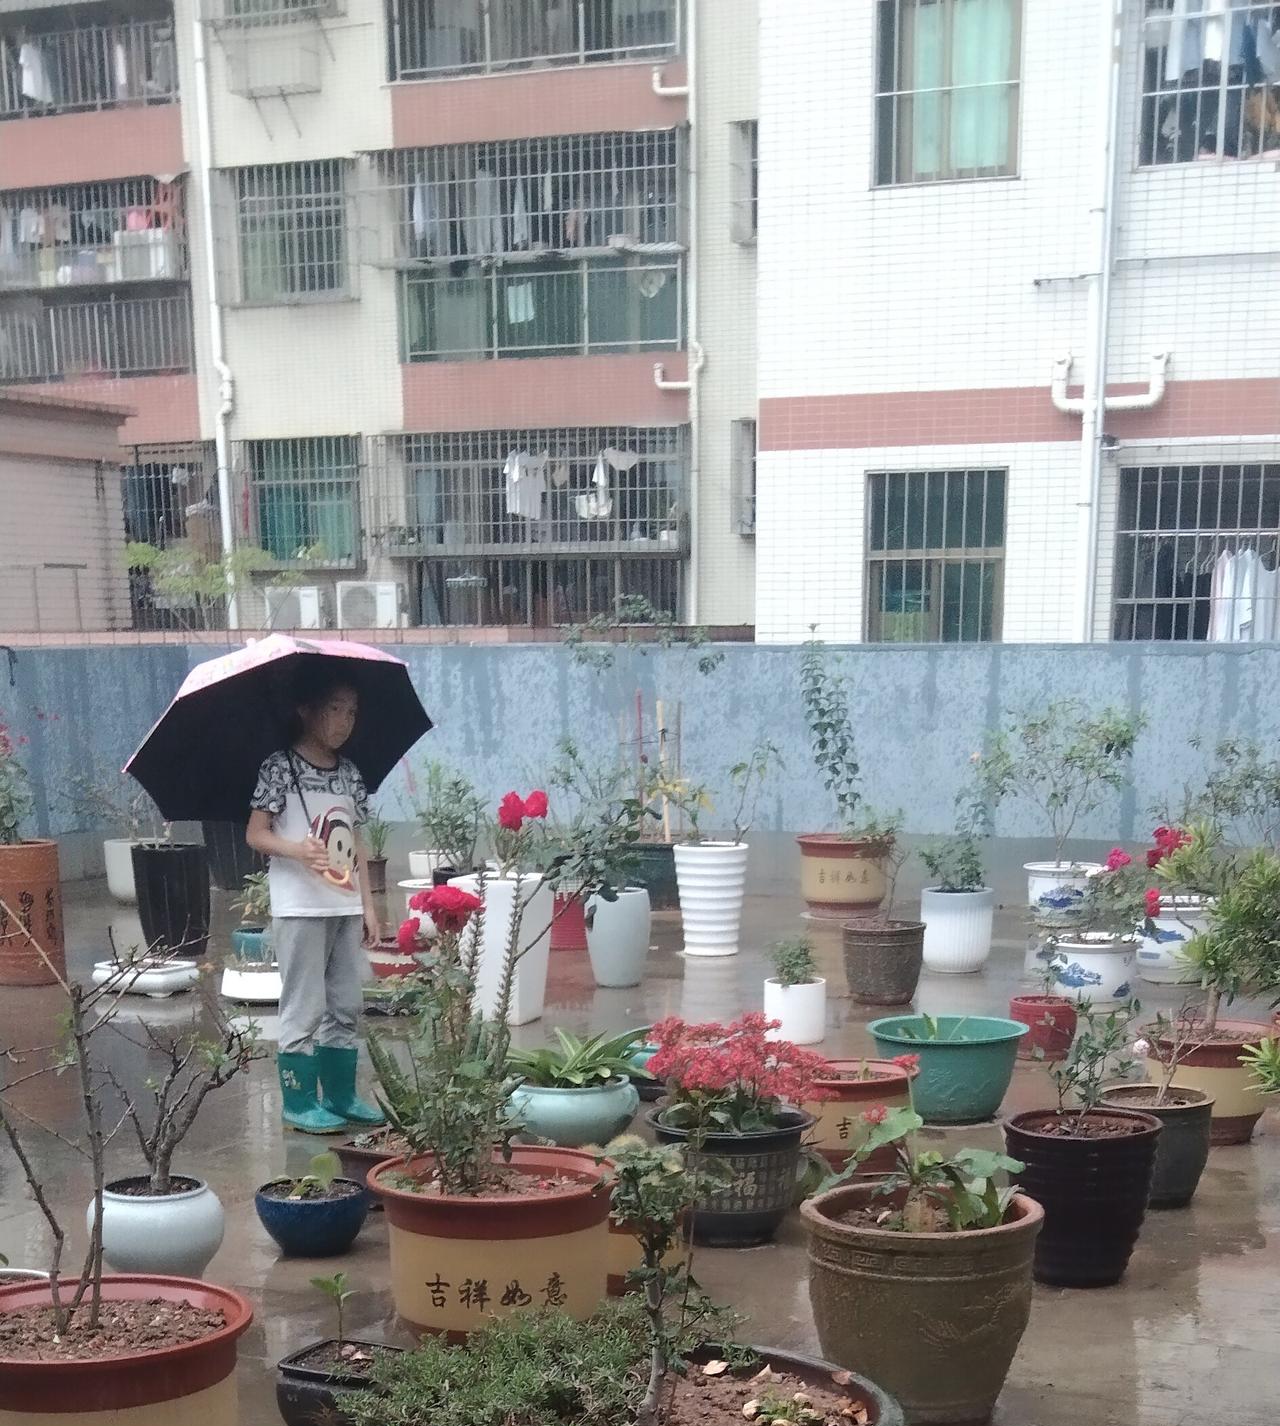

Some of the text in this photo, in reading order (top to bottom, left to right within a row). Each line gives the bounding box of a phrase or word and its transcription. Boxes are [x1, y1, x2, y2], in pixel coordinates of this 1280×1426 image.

[836, 1116, 852, 1140] 吉
[733, 1170, 758, 1197] 福
[425, 1271, 569, 1313] 吉祥如意
